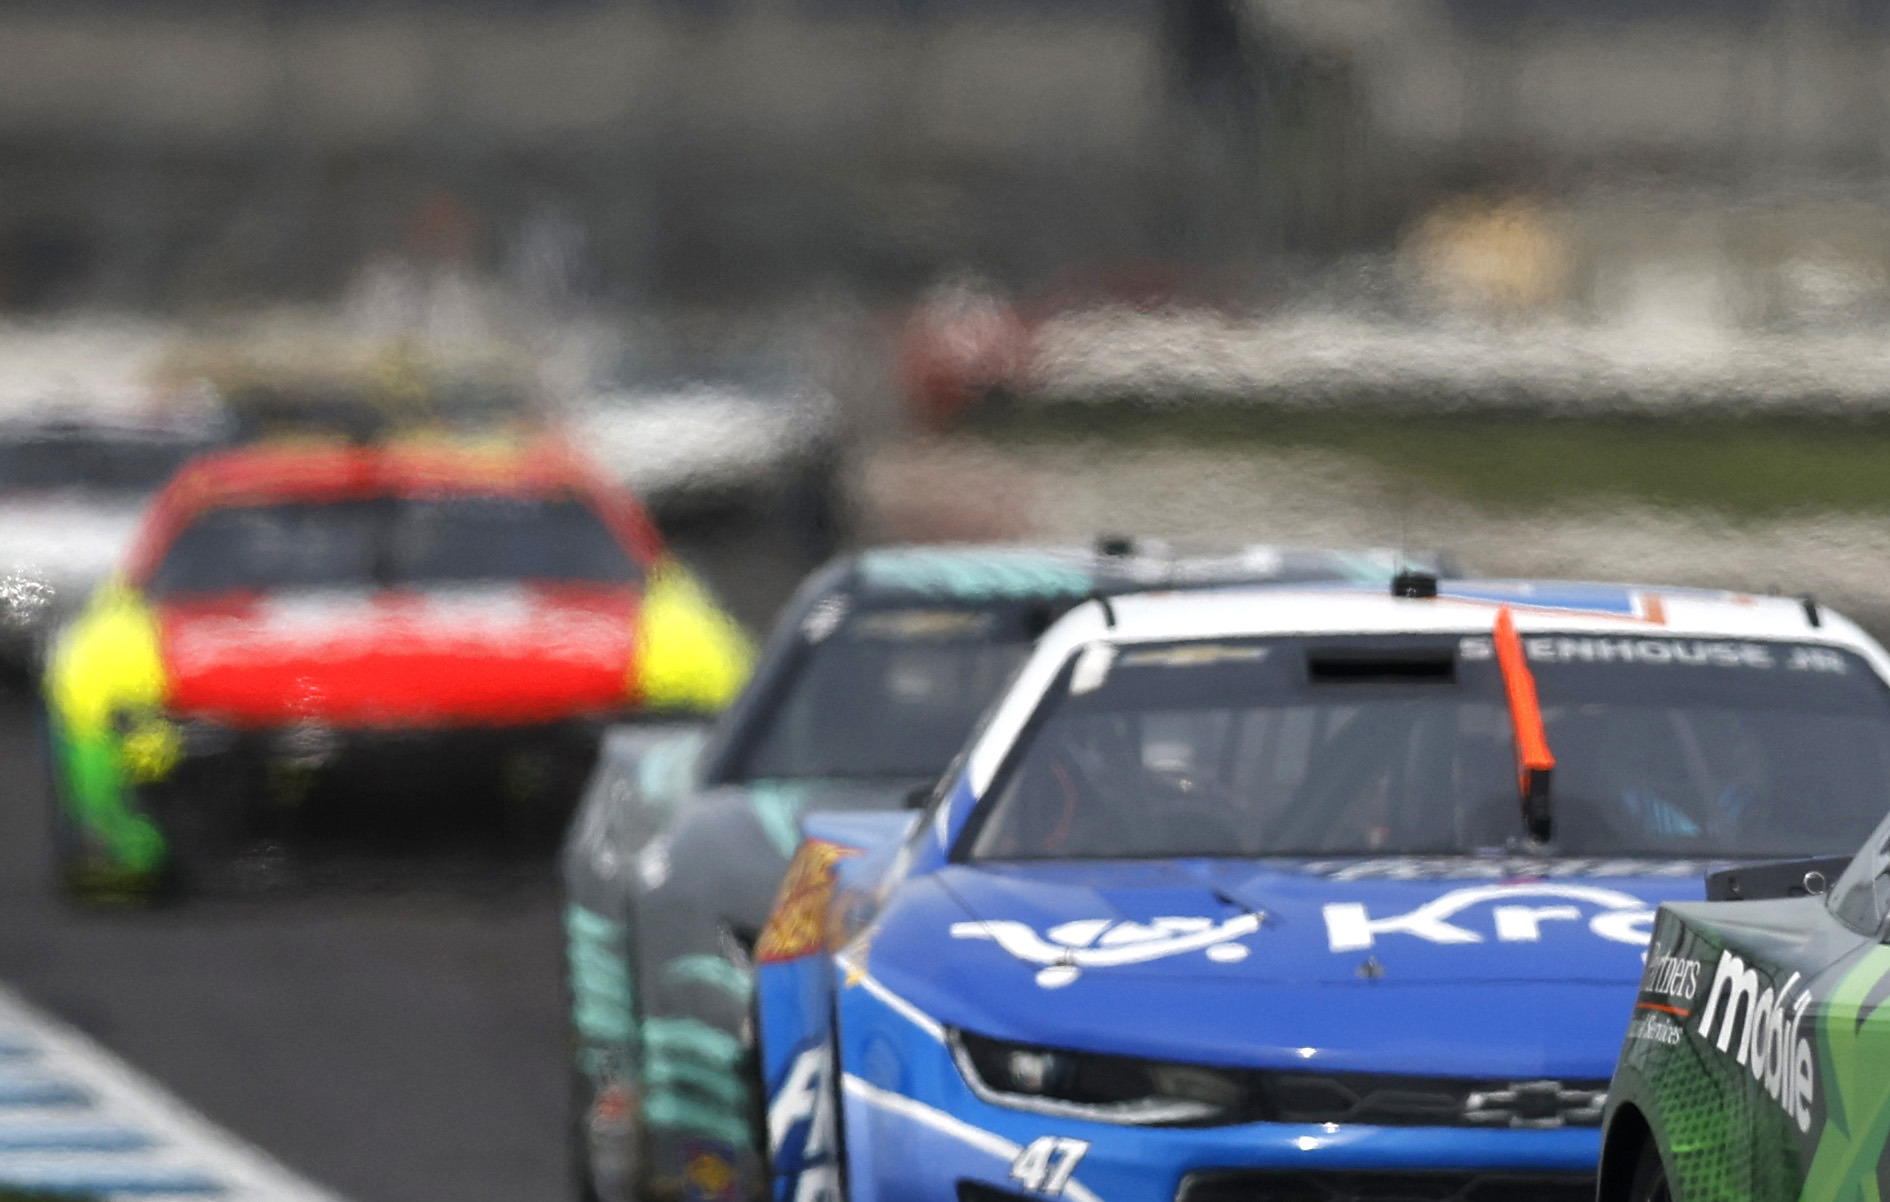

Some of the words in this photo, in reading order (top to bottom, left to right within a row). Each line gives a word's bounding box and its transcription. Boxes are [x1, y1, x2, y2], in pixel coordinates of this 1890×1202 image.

[1459, 636, 1775, 669] SENHOUSE
[1322, 882, 1660, 953] Kro
[1697, 949, 1814, 1134] mobile
[1009, 1134, 1090, 1196] 47
